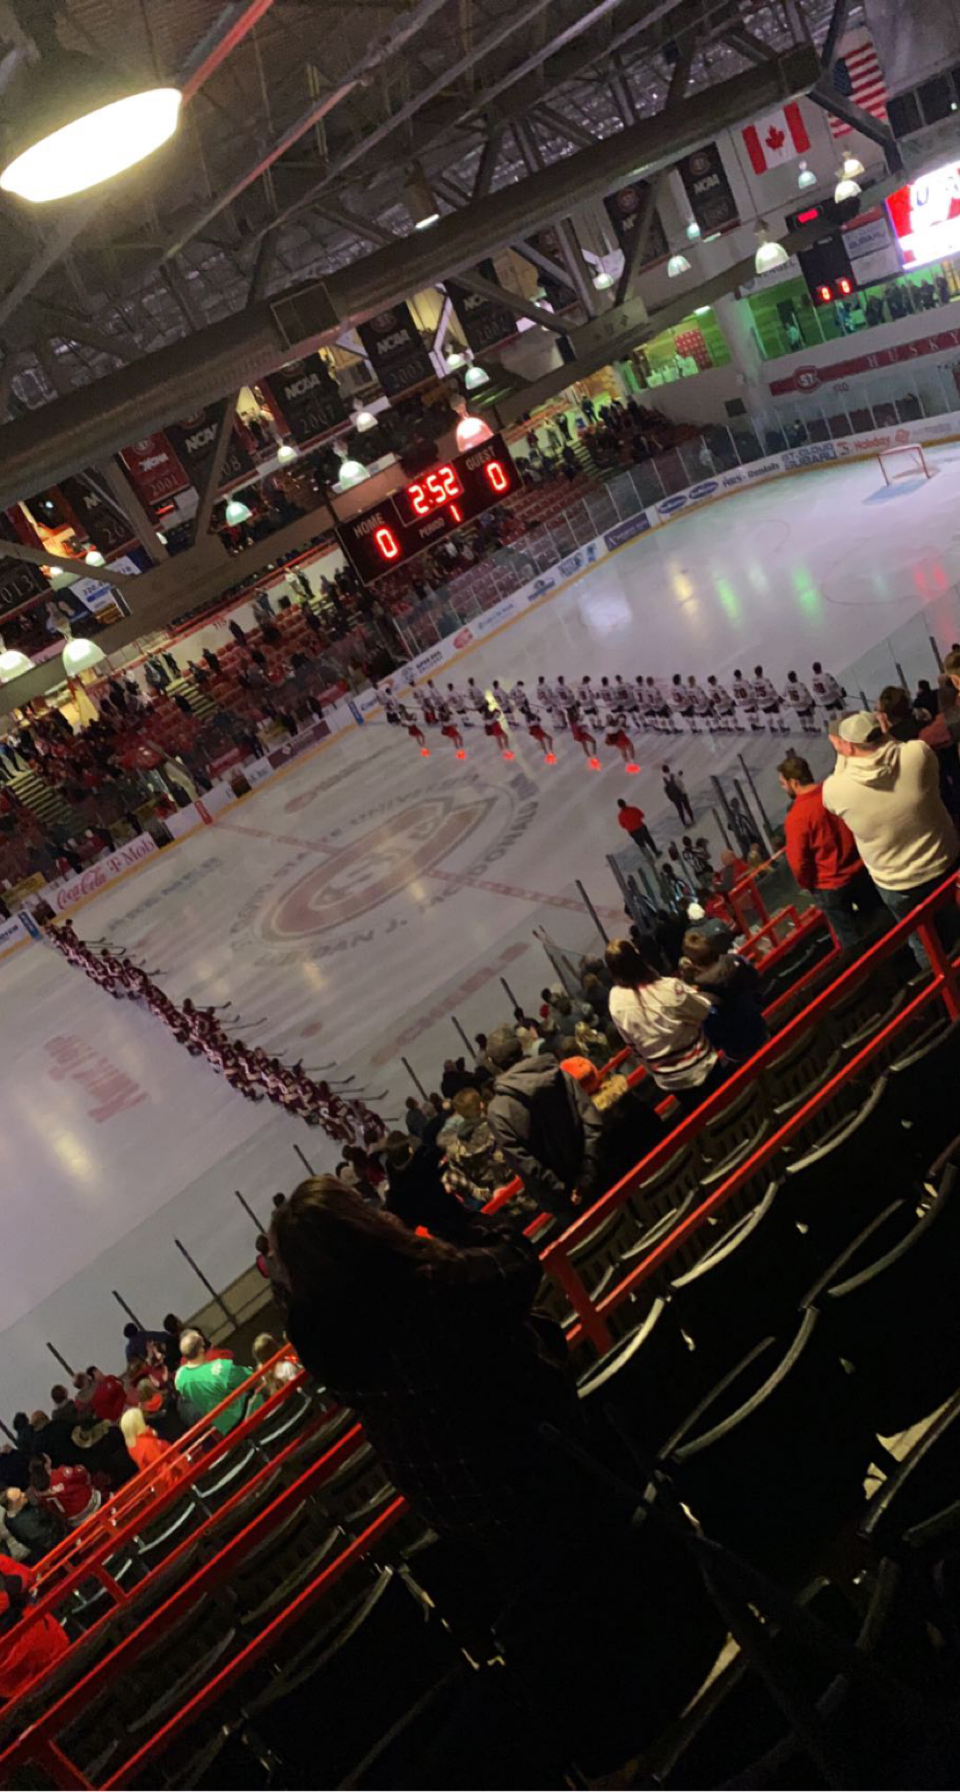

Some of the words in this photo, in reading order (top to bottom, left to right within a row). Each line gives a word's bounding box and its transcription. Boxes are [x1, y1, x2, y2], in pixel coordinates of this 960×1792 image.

[375, 329, 412, 356] NCAA
[283, 372, 322, 401] NCAA
[185, 422, 220, 453] NCA
[465, 446, 496, 472] GUEST
[486, 461, 508, 491] 0
[407, 466, 459, 515] 2:52
[353, 512, 386, 539] HOME
[449, 504, 461, 523] 1
[418, 517, 446, 539] PERIOD
[375, 527, 399, 559] 0
